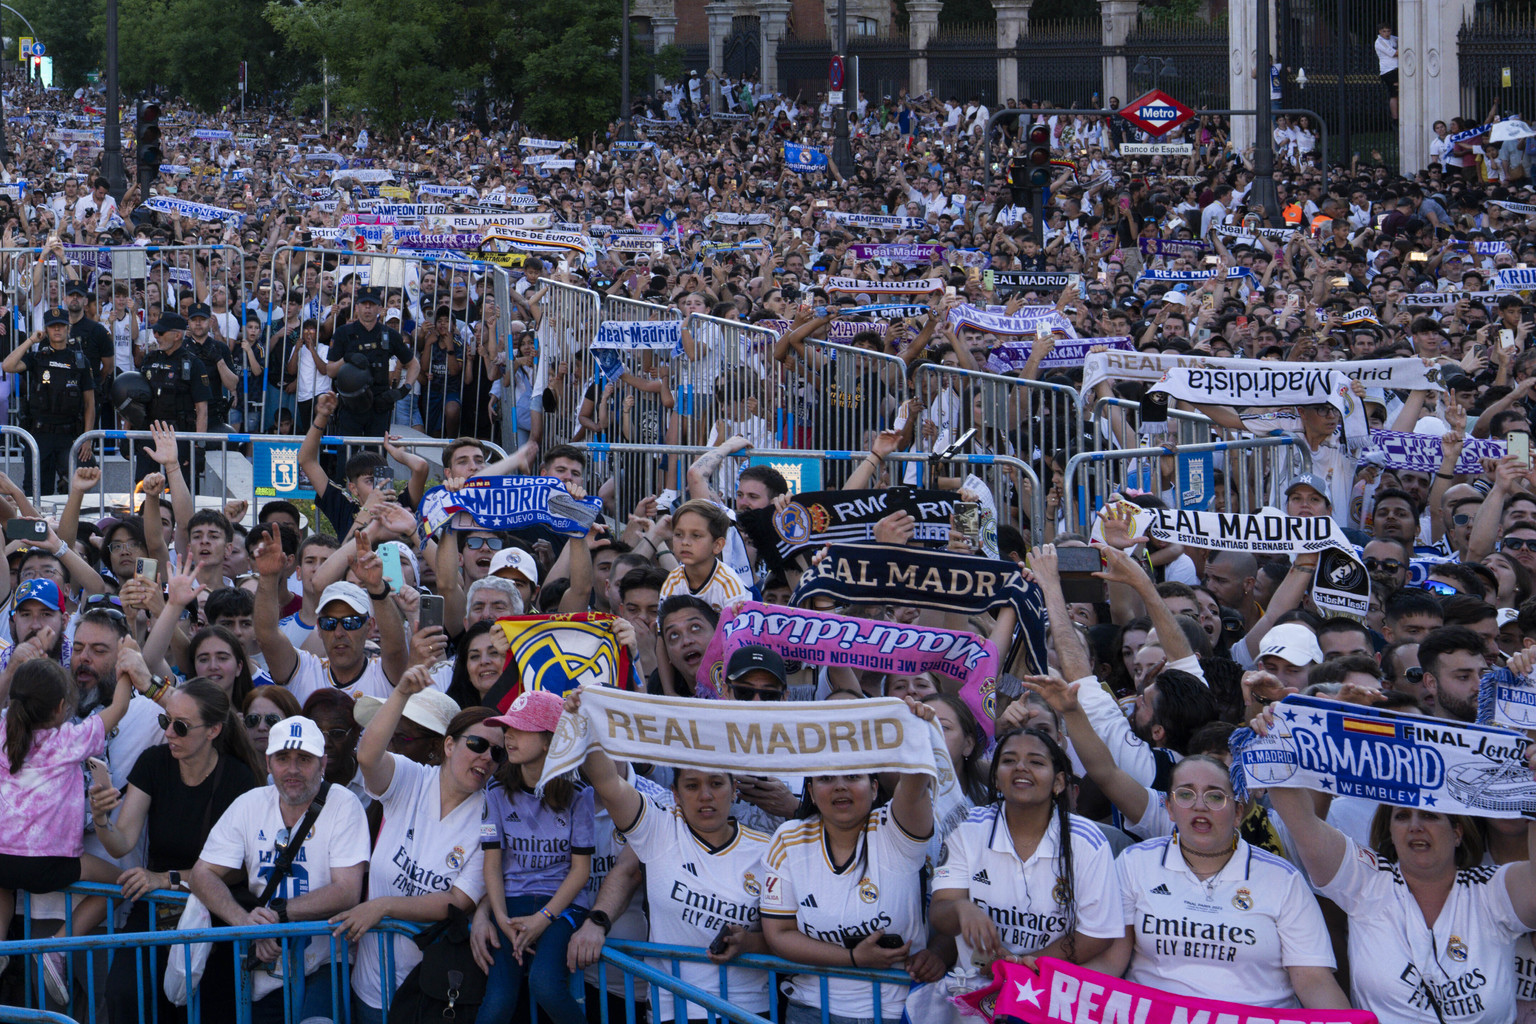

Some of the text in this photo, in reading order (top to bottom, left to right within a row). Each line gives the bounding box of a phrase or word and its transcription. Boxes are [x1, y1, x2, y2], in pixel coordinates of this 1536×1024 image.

[1142, 108, 1174, 118] Metro
[1123, 145, 1189, 156] Banco de España
[156, 201, 221, 219] CAMPEONES
[416, 205, 428, 215] DE
[458, 217, 530, 227] REAL MADRID
[848, 213, 925, 230] CAMPEONES 15
[1219, 225, 1244, 235] Real
[362, 227, 421, 240] Real adrid
[494, 226, 524, 237] REYES
[529, 232, 542, 240] DE
[864, 247, 890, 256] Real
[993, 276, 1069, 286] EAL MADRID
[1154, 266, 1241, 280] REAL MADID
[827, 277, 859, 288] Real
[1403, 291, 1452, 305] Real
[880, 308, 904, 319] POR
[907, 306, 923, 317] LA
[597, 325, 678, 345] Real Madrid
[1107, 353, 1165, 372] REAL
[1187, 368, 1333, 399] Madridista
[502, 477, 566, 492] EUROPA
[506, 513, 534, 526] NUEVO
[1218, 513, 1332, 542] MADRID
[1178, 533, 1294, 552] ESTADIO SANTIAGO BERNABEU
[799, 555, 878, 590] REAL
[722, 609, 991, 671] Madridista
[776, 644, 826, 663] GUAPA,
[897, 659, 917, 673] ME
[920, 660, 969, 682] PADRES
[289, 724, 302, 739] 10
[604, 707, 905, 755] REAL MADRID
[1403, 725, 1532, 764] FINAL Lond
[1246, 750, 1293, 764] R.MADRID
[1292, 728, 1445, 791] R.MADRID
[1339, 781, 1419, 804] WEMBLEY
[972, 876, 992, 886] adidas
[670, 879, 762, 923] Emirates
[681, 907, 704, 926] FLY
[972, 897, 1068, 933] Emirates
[802, 910, 893, 947] Emirates
[1141, 913, 1258, 946] Emirates
[1156, 938, 1238, 963] FLY BETTER
